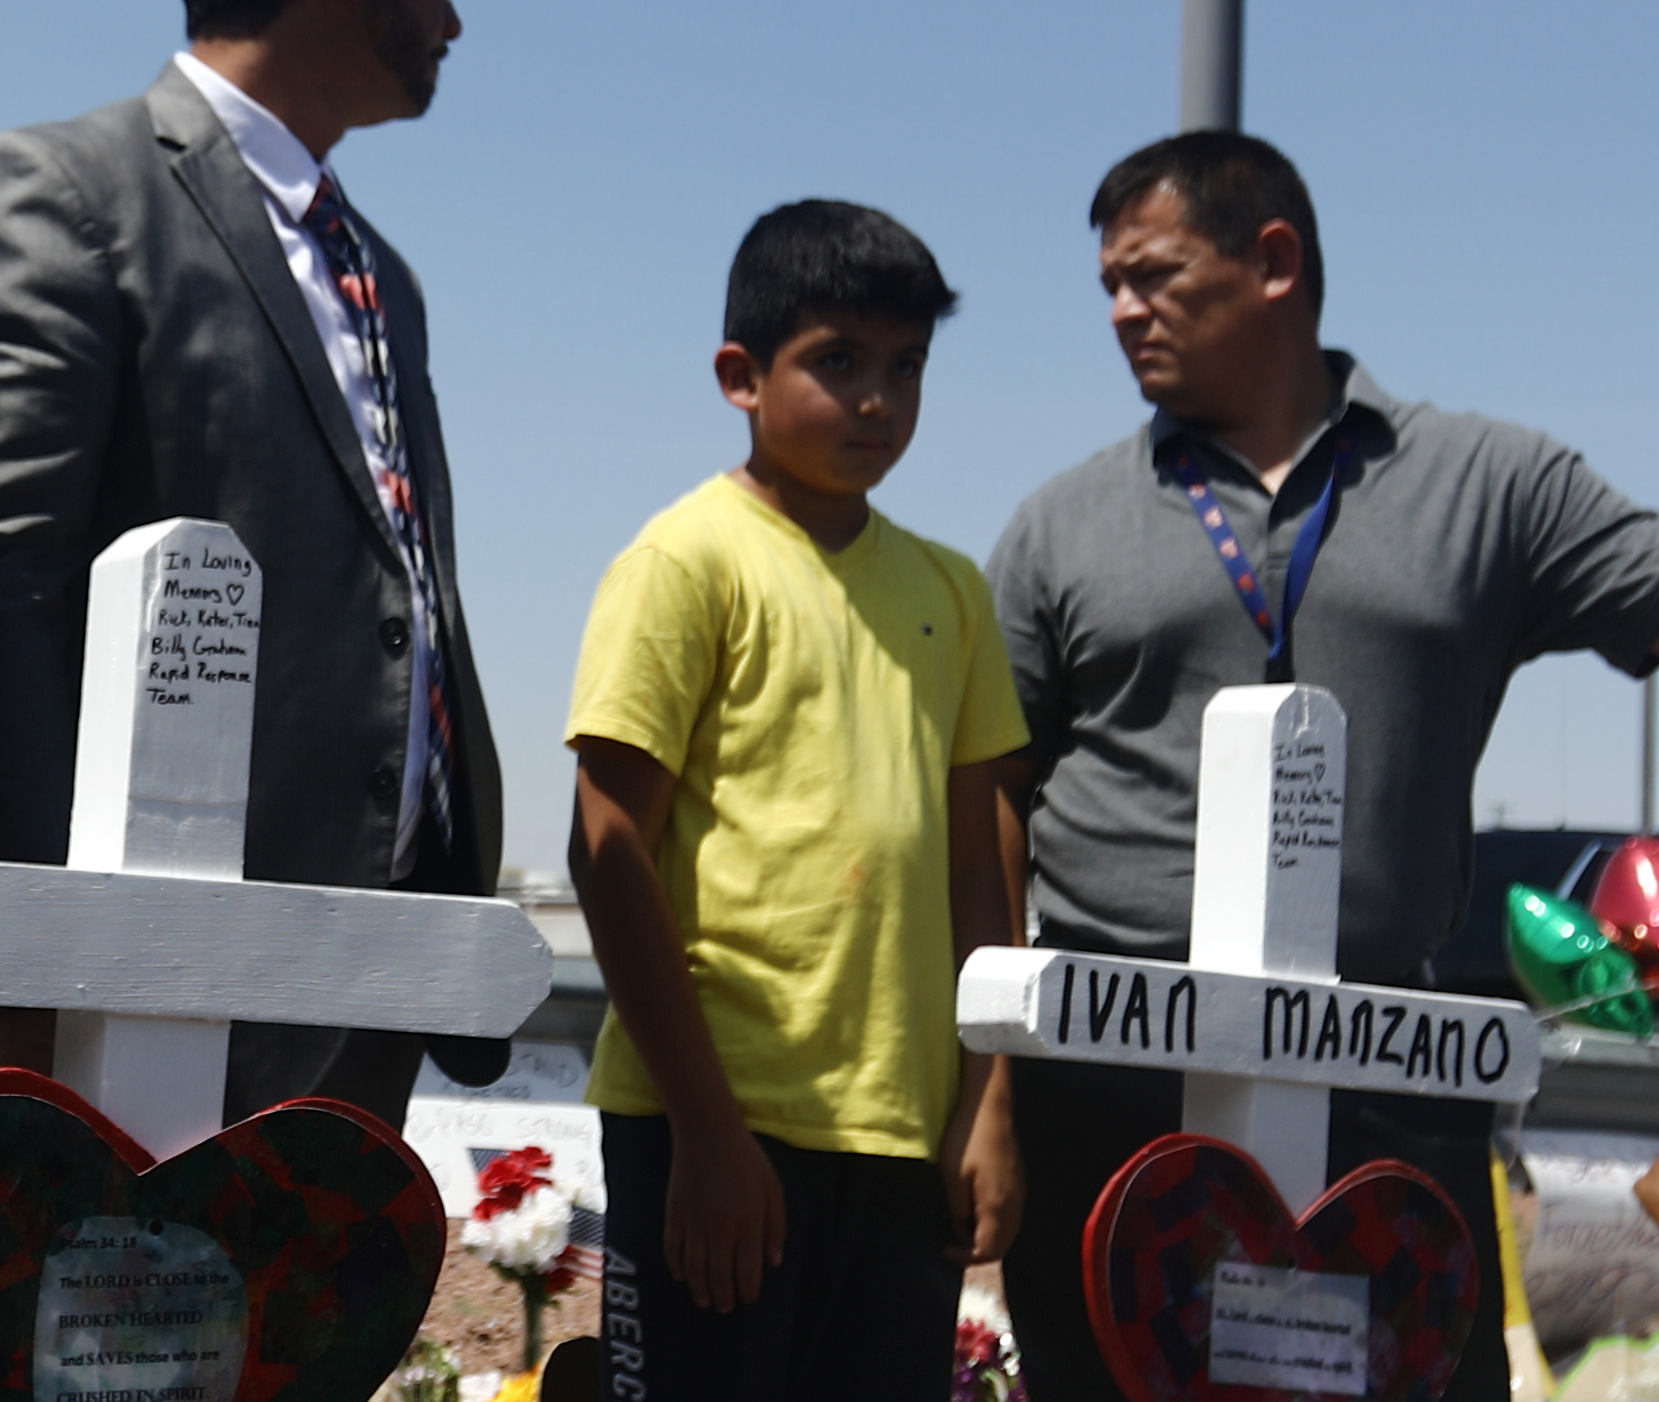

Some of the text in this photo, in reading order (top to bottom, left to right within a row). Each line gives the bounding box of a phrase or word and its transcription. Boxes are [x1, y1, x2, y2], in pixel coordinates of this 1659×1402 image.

[165, 547, 253, 577] In Loving
[150, 633, 187, 661] Billy
[149, 662, 190, 685] Rapid
[1057, 962, 1510, 1088] IVAN MANZANO
[122, 1236, 138, 1250] 18
[60, 1275, 82, 1290] The
[84, 1273, 131, 1290] LORD
[145, 1271, 194, 1289] CLOSE
[210, 1271, 230, 1286] the
[58, 1309, 204, 1330] BROKEN HEARTED
[61, 1348, 221, 1367] and SAVES those who are
